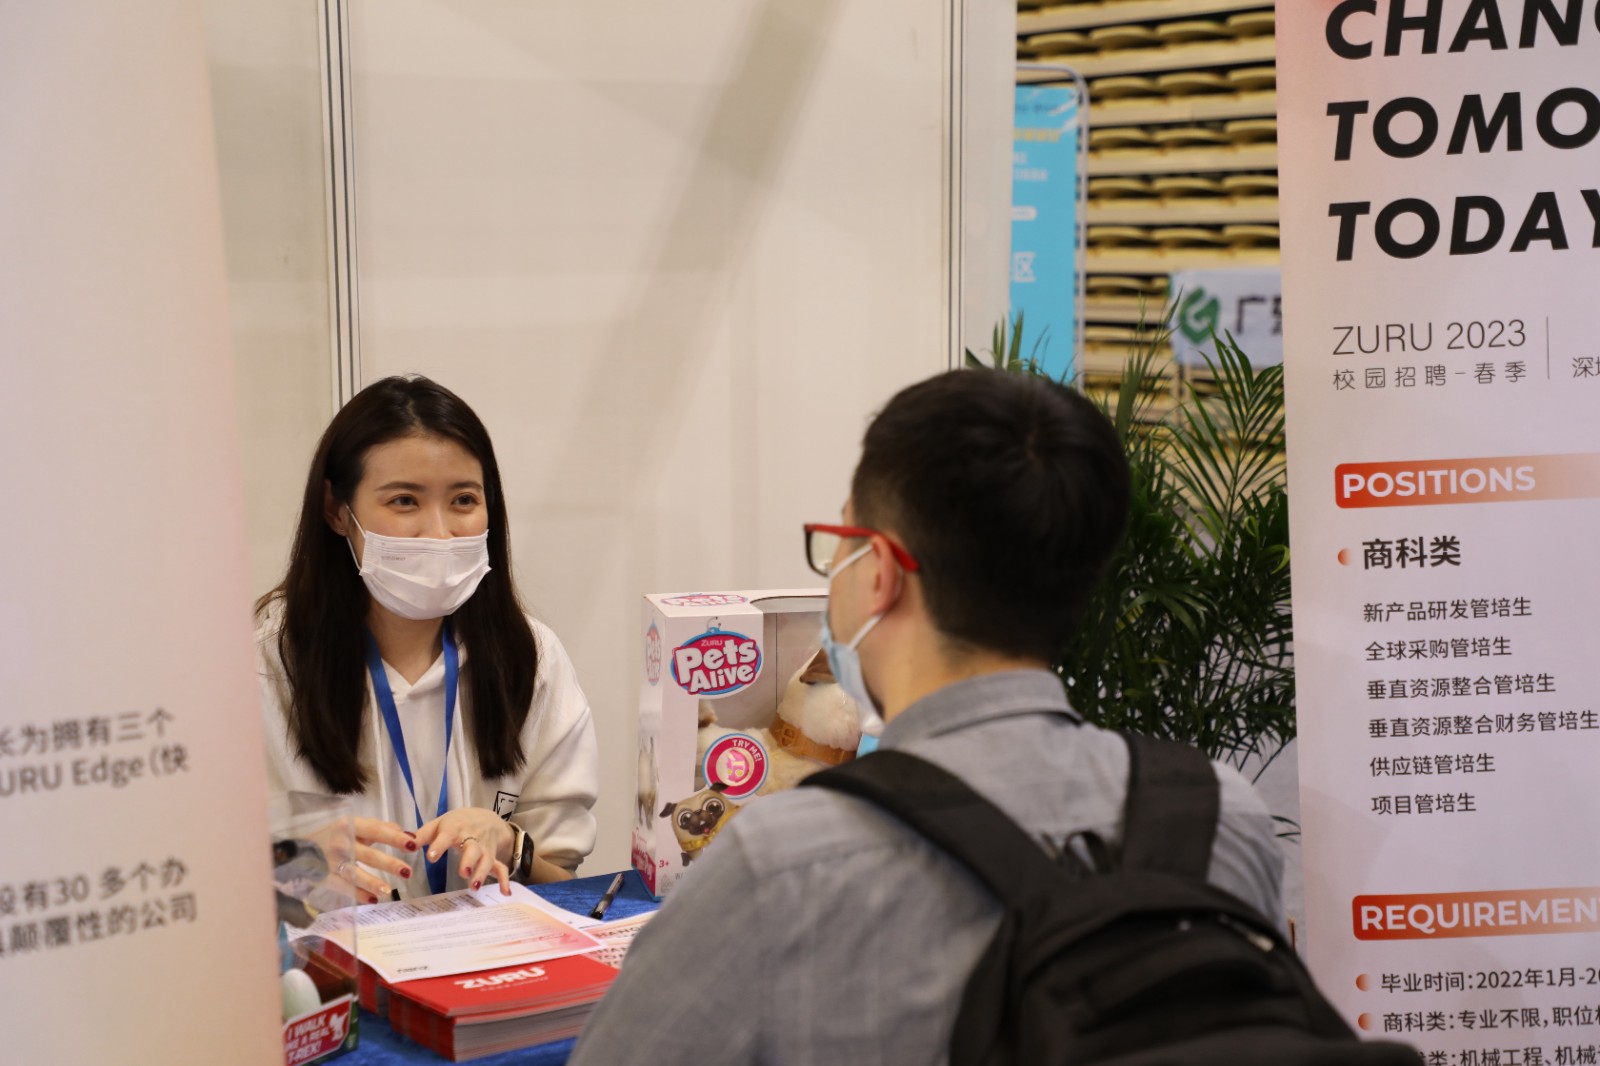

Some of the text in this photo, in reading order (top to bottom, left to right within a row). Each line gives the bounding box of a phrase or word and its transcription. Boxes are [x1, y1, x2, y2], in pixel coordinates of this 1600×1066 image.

[1325, 0, 1600, 60] CHAN
[1332, 319, 1526, 355] ZURU 2023
[1342, 466, 1536, 499] POSITIONS
[1362, 535, 1462, 570] 商科类
[1362, 596, 1533, 623] 新产品研发管培生
[675, 638, 757, 685] Pets
[1365, 636, 1513, 662] 全球采购管培生
[690, 664, 754, 693] Alive
[1366, 673, 1557, 700] 垂直资源整合管培生
[1368, 709, 1600, 739] 垂直资源整合财务管培生
[732, 739, 751, 749] TRY
[1369, 752, 1497, 777] 供应链管培生
[1371, 792, 1478, 816] 项目管培生
[0, 891, 197, 957] 颠覆性的公司
[1360, 896, 1600, 934] REQUIREMEN
[454, 966, 546, 989] ZURU
[1381, 967, 1600, 994] 毕业时间:2022年1月-2
